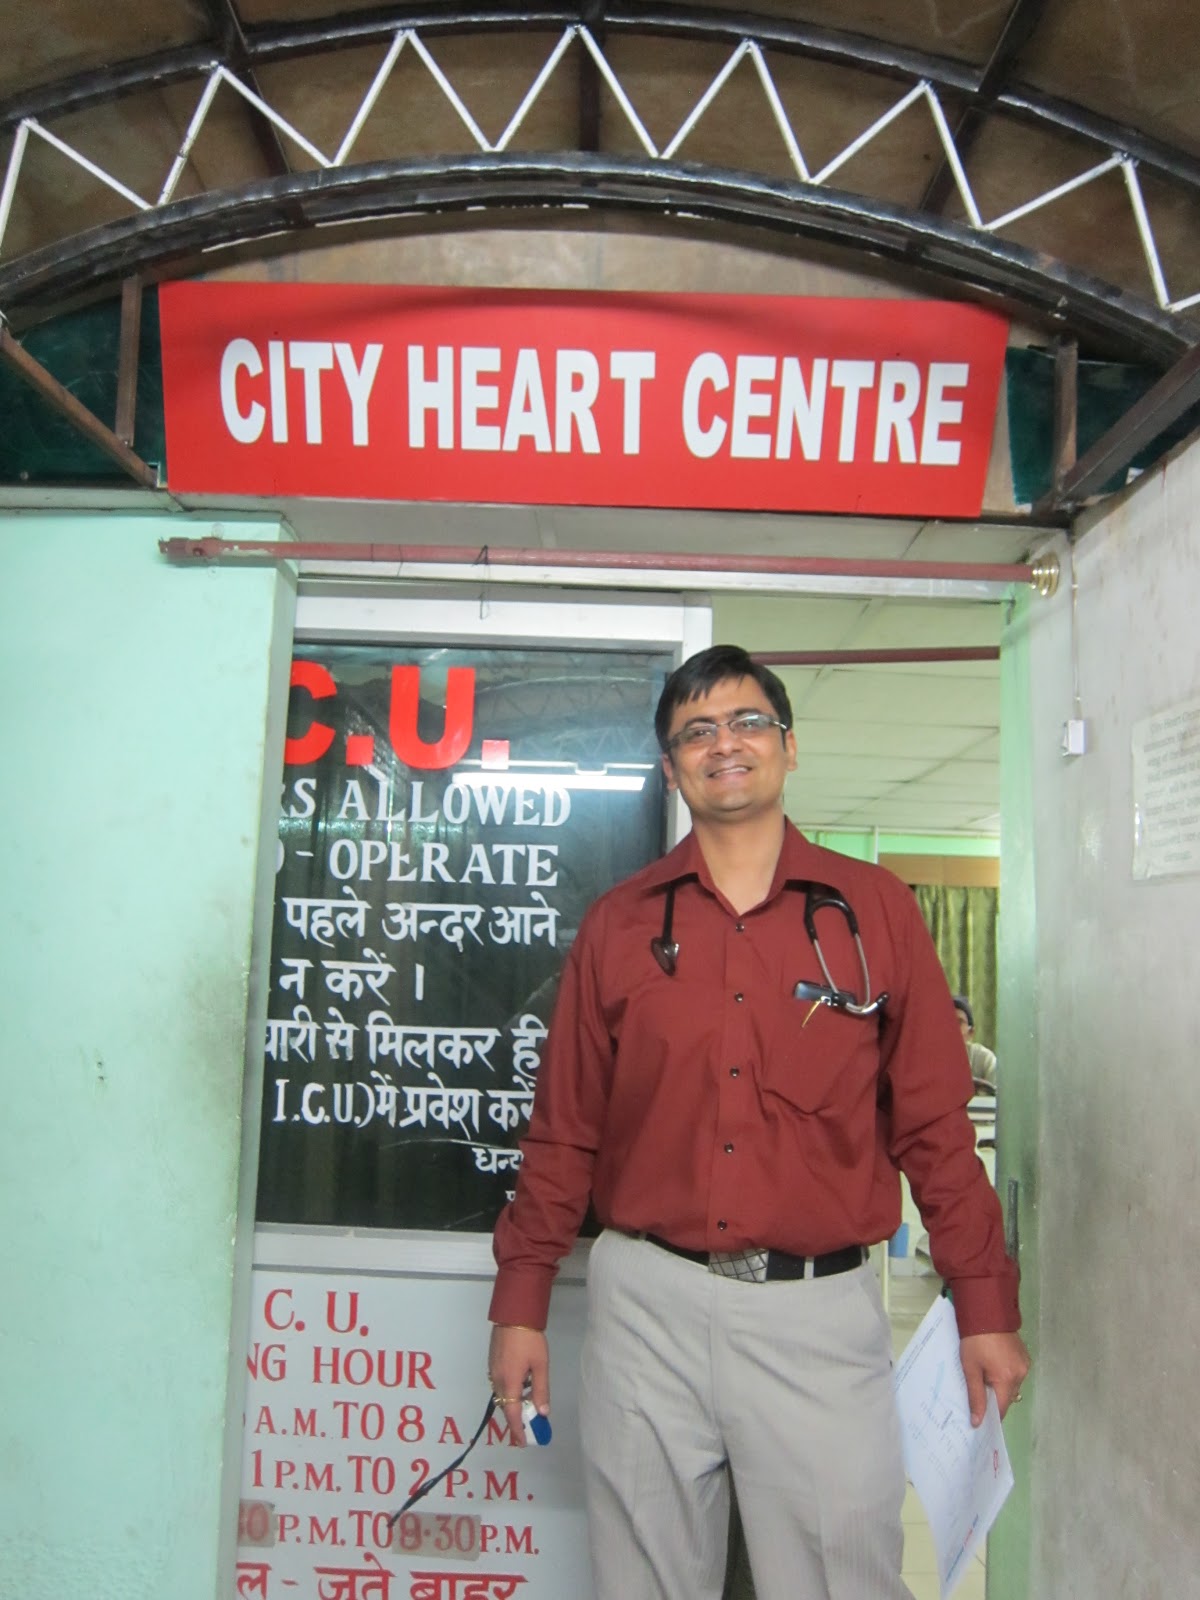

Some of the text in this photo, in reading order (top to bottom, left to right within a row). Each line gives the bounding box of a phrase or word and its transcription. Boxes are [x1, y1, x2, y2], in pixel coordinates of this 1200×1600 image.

[220, 338, 969, 465] CITY HEART CENTRE
[338, 779, 571, 827] ALLOWED
[329, 839, 558, 887] OPERATE
[282, 885, 561, 952] पहले अन्दर आने
[279, 958, 314, 1000] न
[321, 948, 397, 1006] करें
[324, 1006, 360, 1060] से
[365, 1010, 502, 1072] मिलकर
[399, 1072, 484, 1140] प्रवेश
[312, 1346, 436, 1390] HOUR
